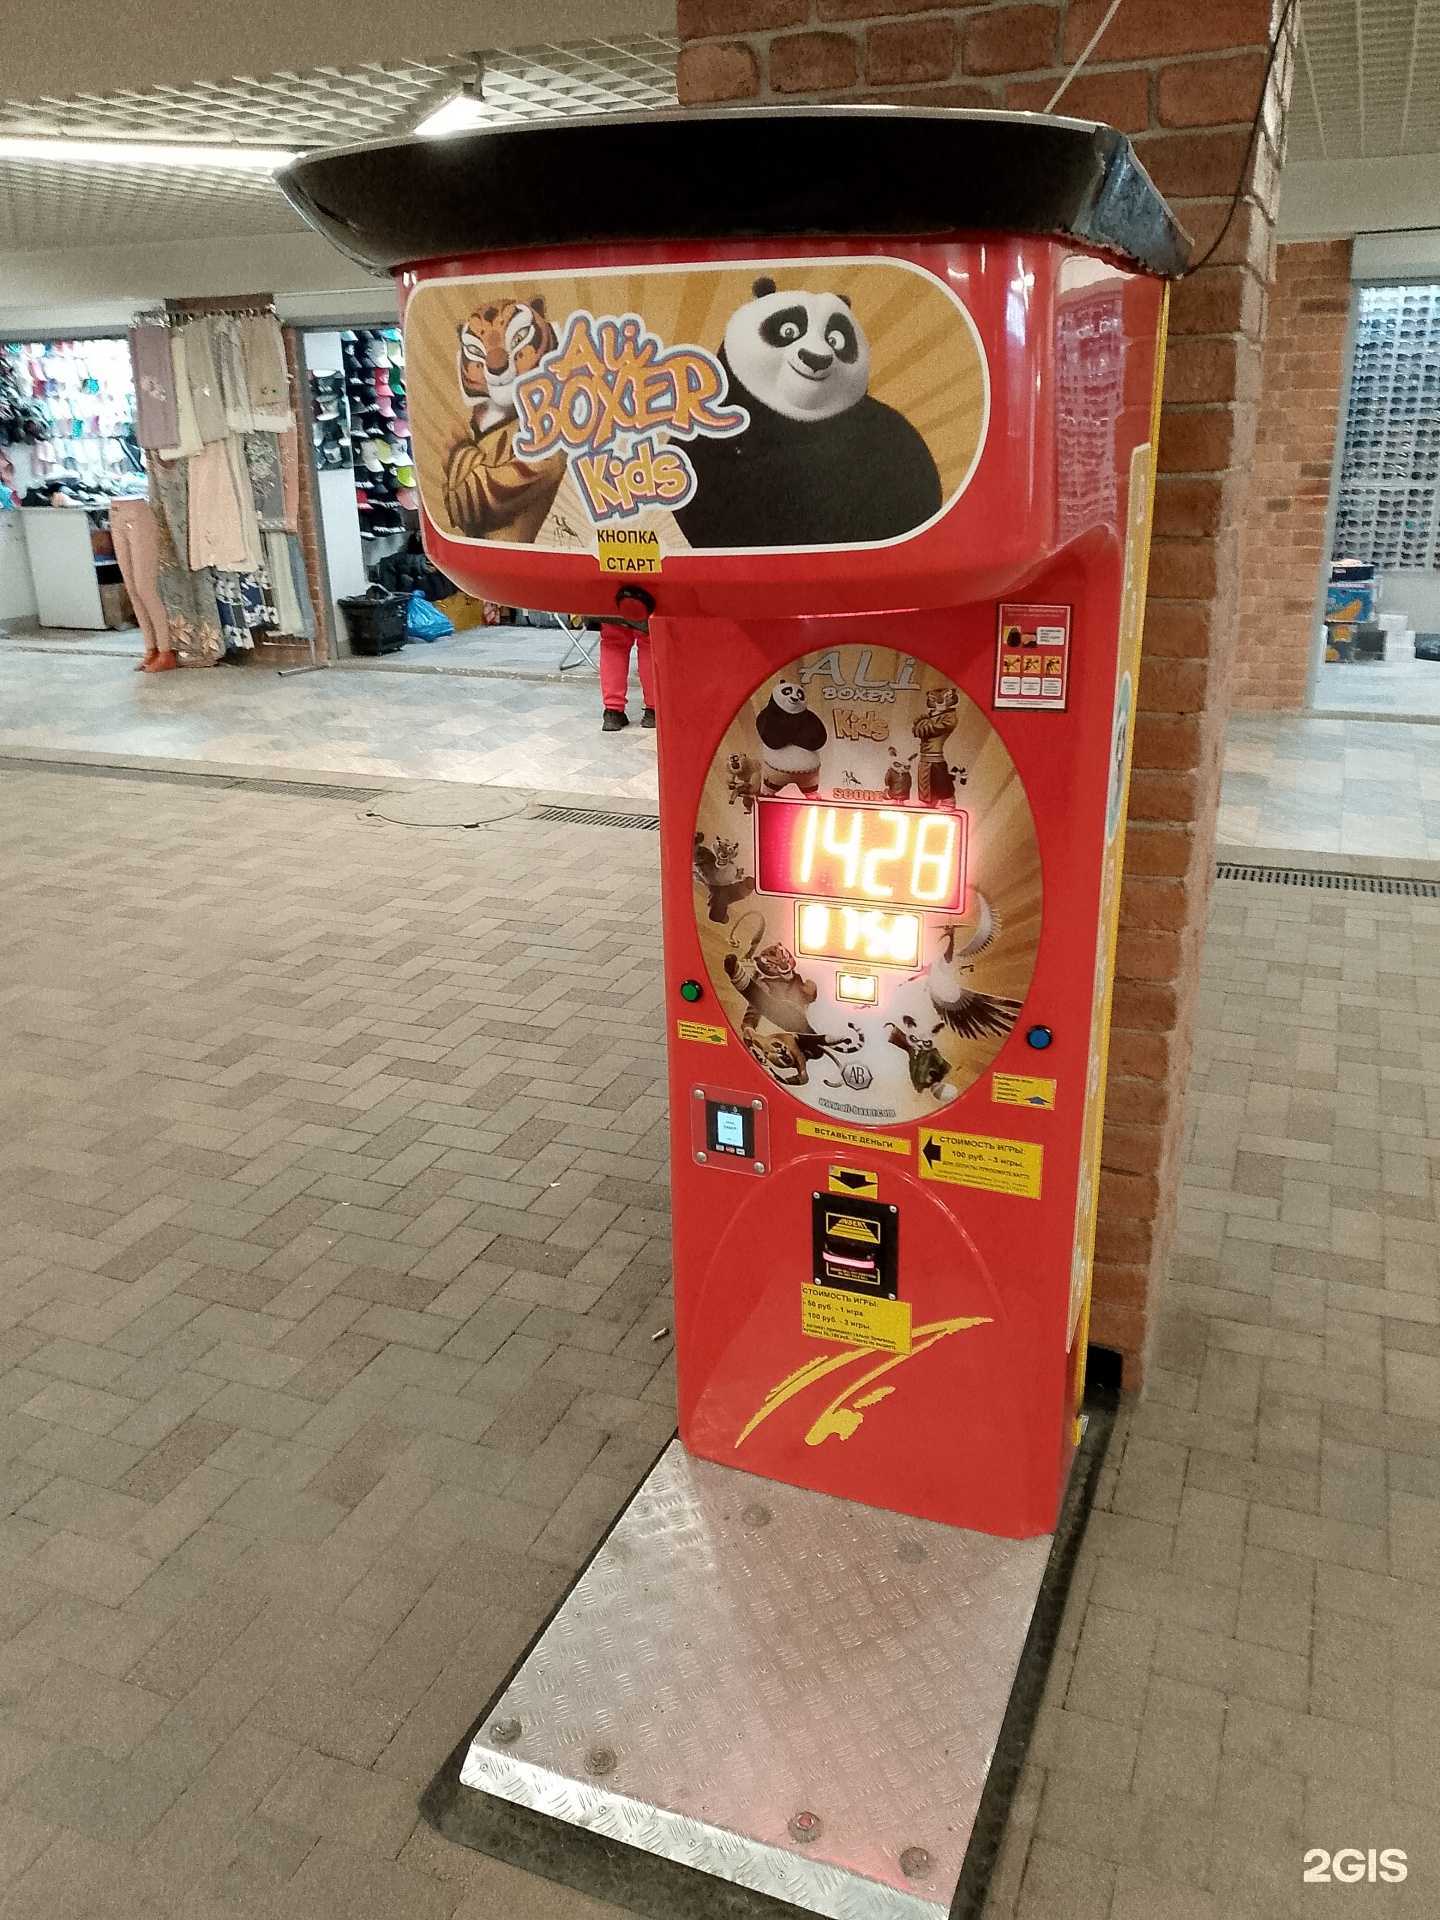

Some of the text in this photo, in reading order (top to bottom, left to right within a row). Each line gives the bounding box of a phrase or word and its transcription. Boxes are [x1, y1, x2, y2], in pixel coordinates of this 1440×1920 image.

[515, 350, 746, 453] BOXER
[572, 437, 693, 522] Kids
[597, 529, 658, 544] КНОПКА
[606, 557, 656, 571] СТАРТ
[822, 686, 897, 704] BOXER
[832, 708, 890, 742] Kids
[800, 804, 956, 901] 1428
[814, 1127, 894, 1148] ВСТАВЬТЕ ДЕНЬГИ
[939, 1136, 995, 1150] СТОИМОСТЬ
[802, 1287, 851, 1302] СТОИМОСТЬ
